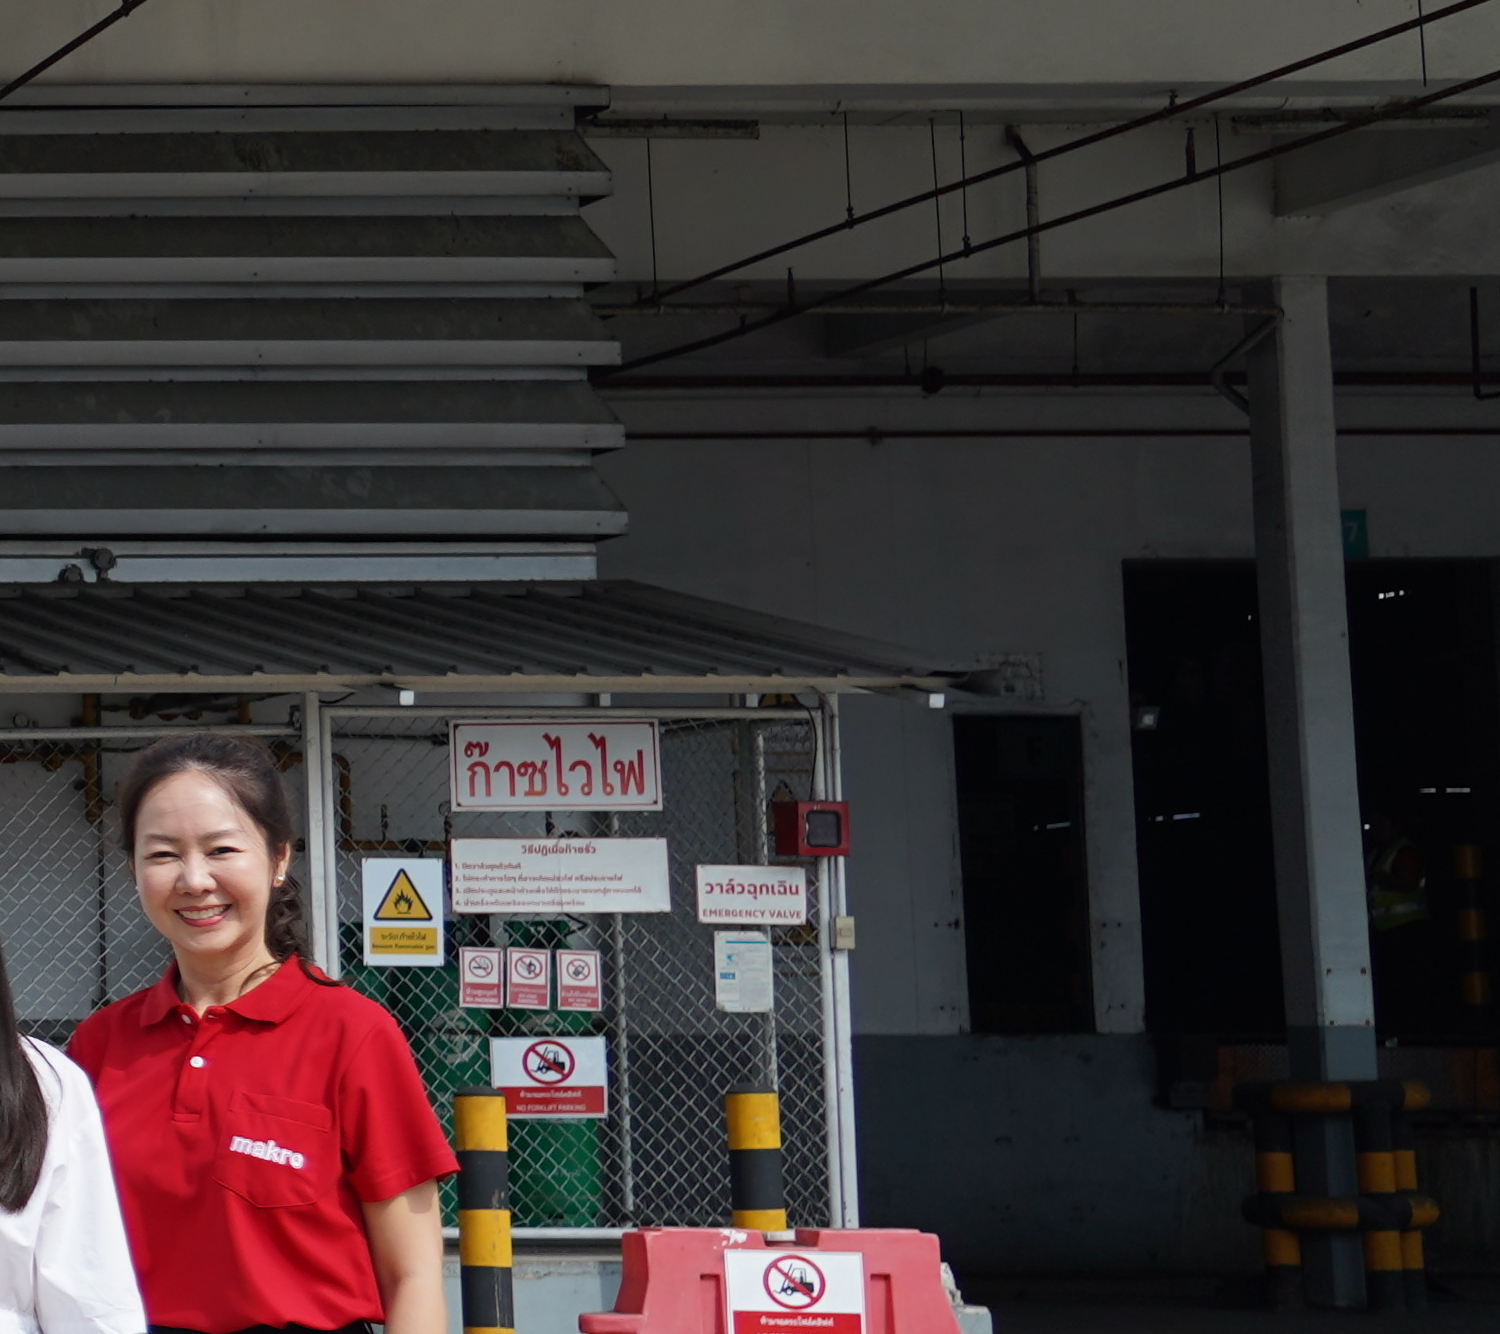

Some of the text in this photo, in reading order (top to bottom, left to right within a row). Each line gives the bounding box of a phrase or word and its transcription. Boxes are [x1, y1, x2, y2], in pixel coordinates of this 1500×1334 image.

[463, 731, 646, 798] ก๊าซไวไฟ
[704, 878, 800, 901] วาล์วฉุกเฉิน
[702, 908, 802, 919] EMERGENCY VALVE
[558, 1103, 587, 1112] PARKING
[228, 1135, 305, 1170] makro
